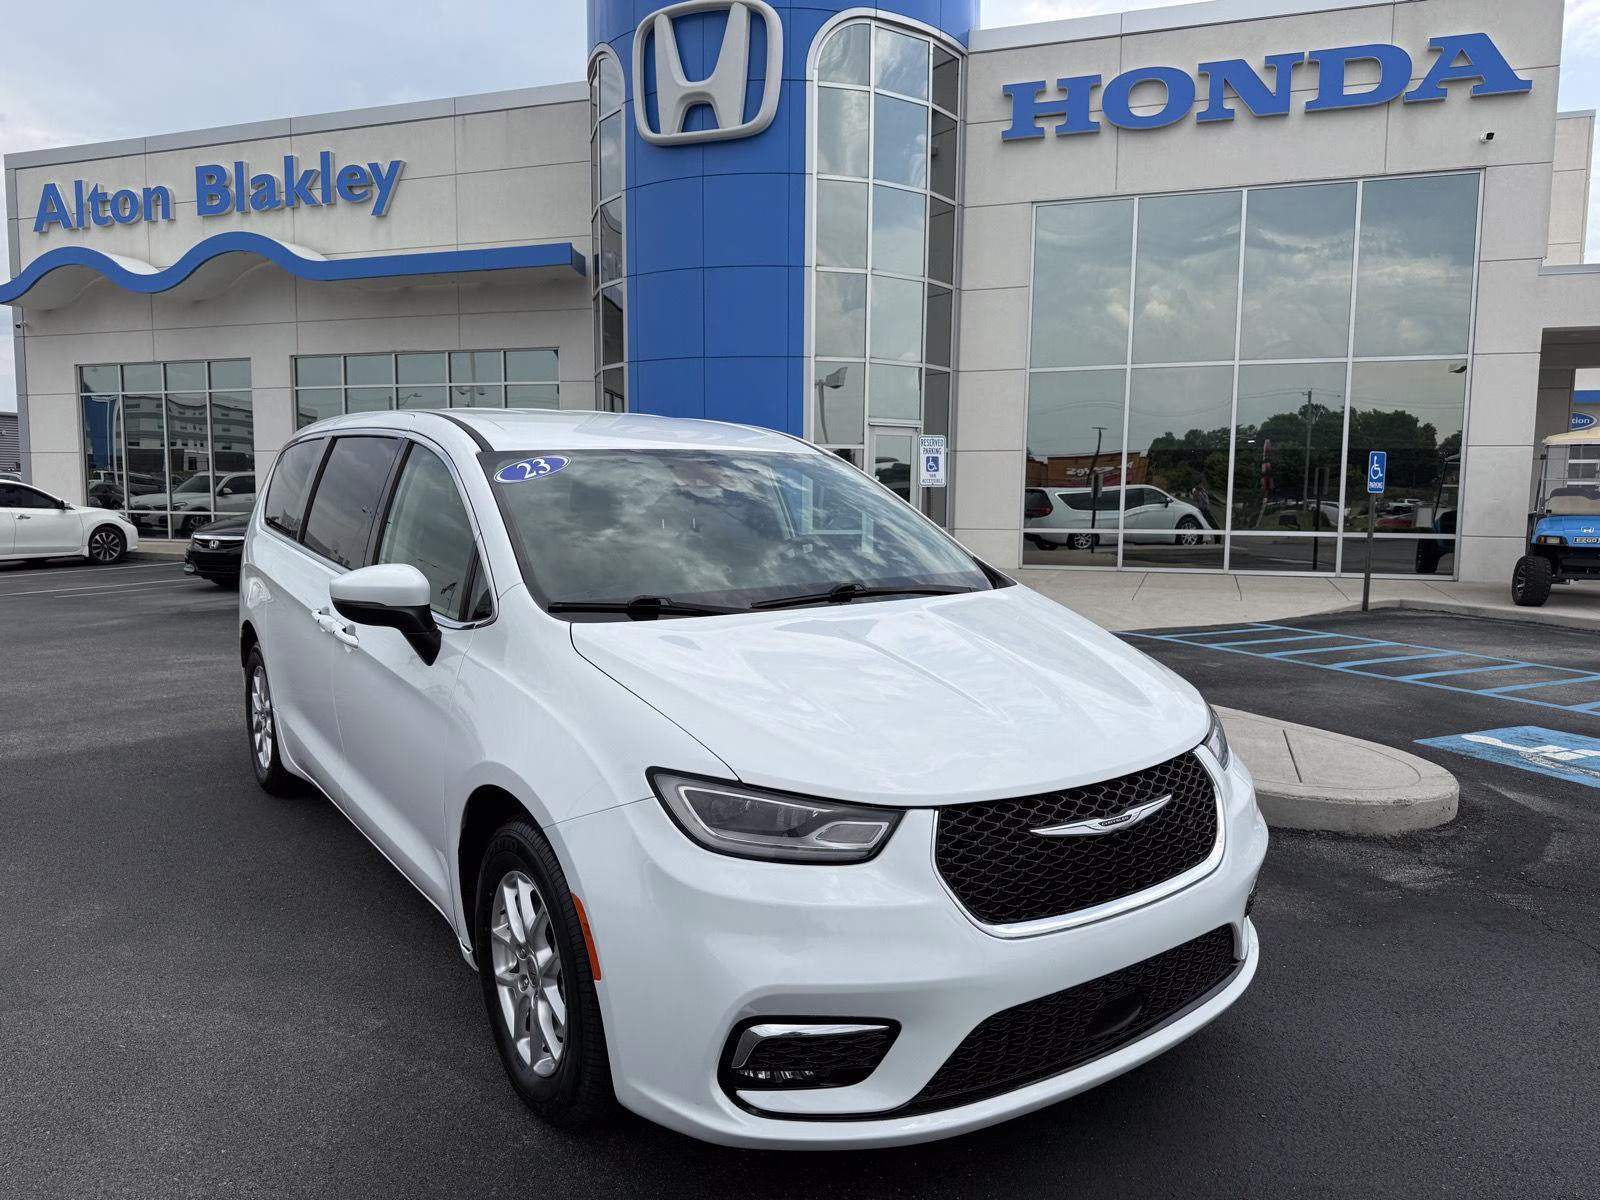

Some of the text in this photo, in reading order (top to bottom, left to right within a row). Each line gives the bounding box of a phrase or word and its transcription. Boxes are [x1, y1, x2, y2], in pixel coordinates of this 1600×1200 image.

[1001, 32, 1534, 142] HONDA
[33, 150, 406, 234] Alton Blakley
[921, 438, 943, 447] RESERVED
[922, 447, 942, 455] PARKING
[516, 458, 551, 479] 23
